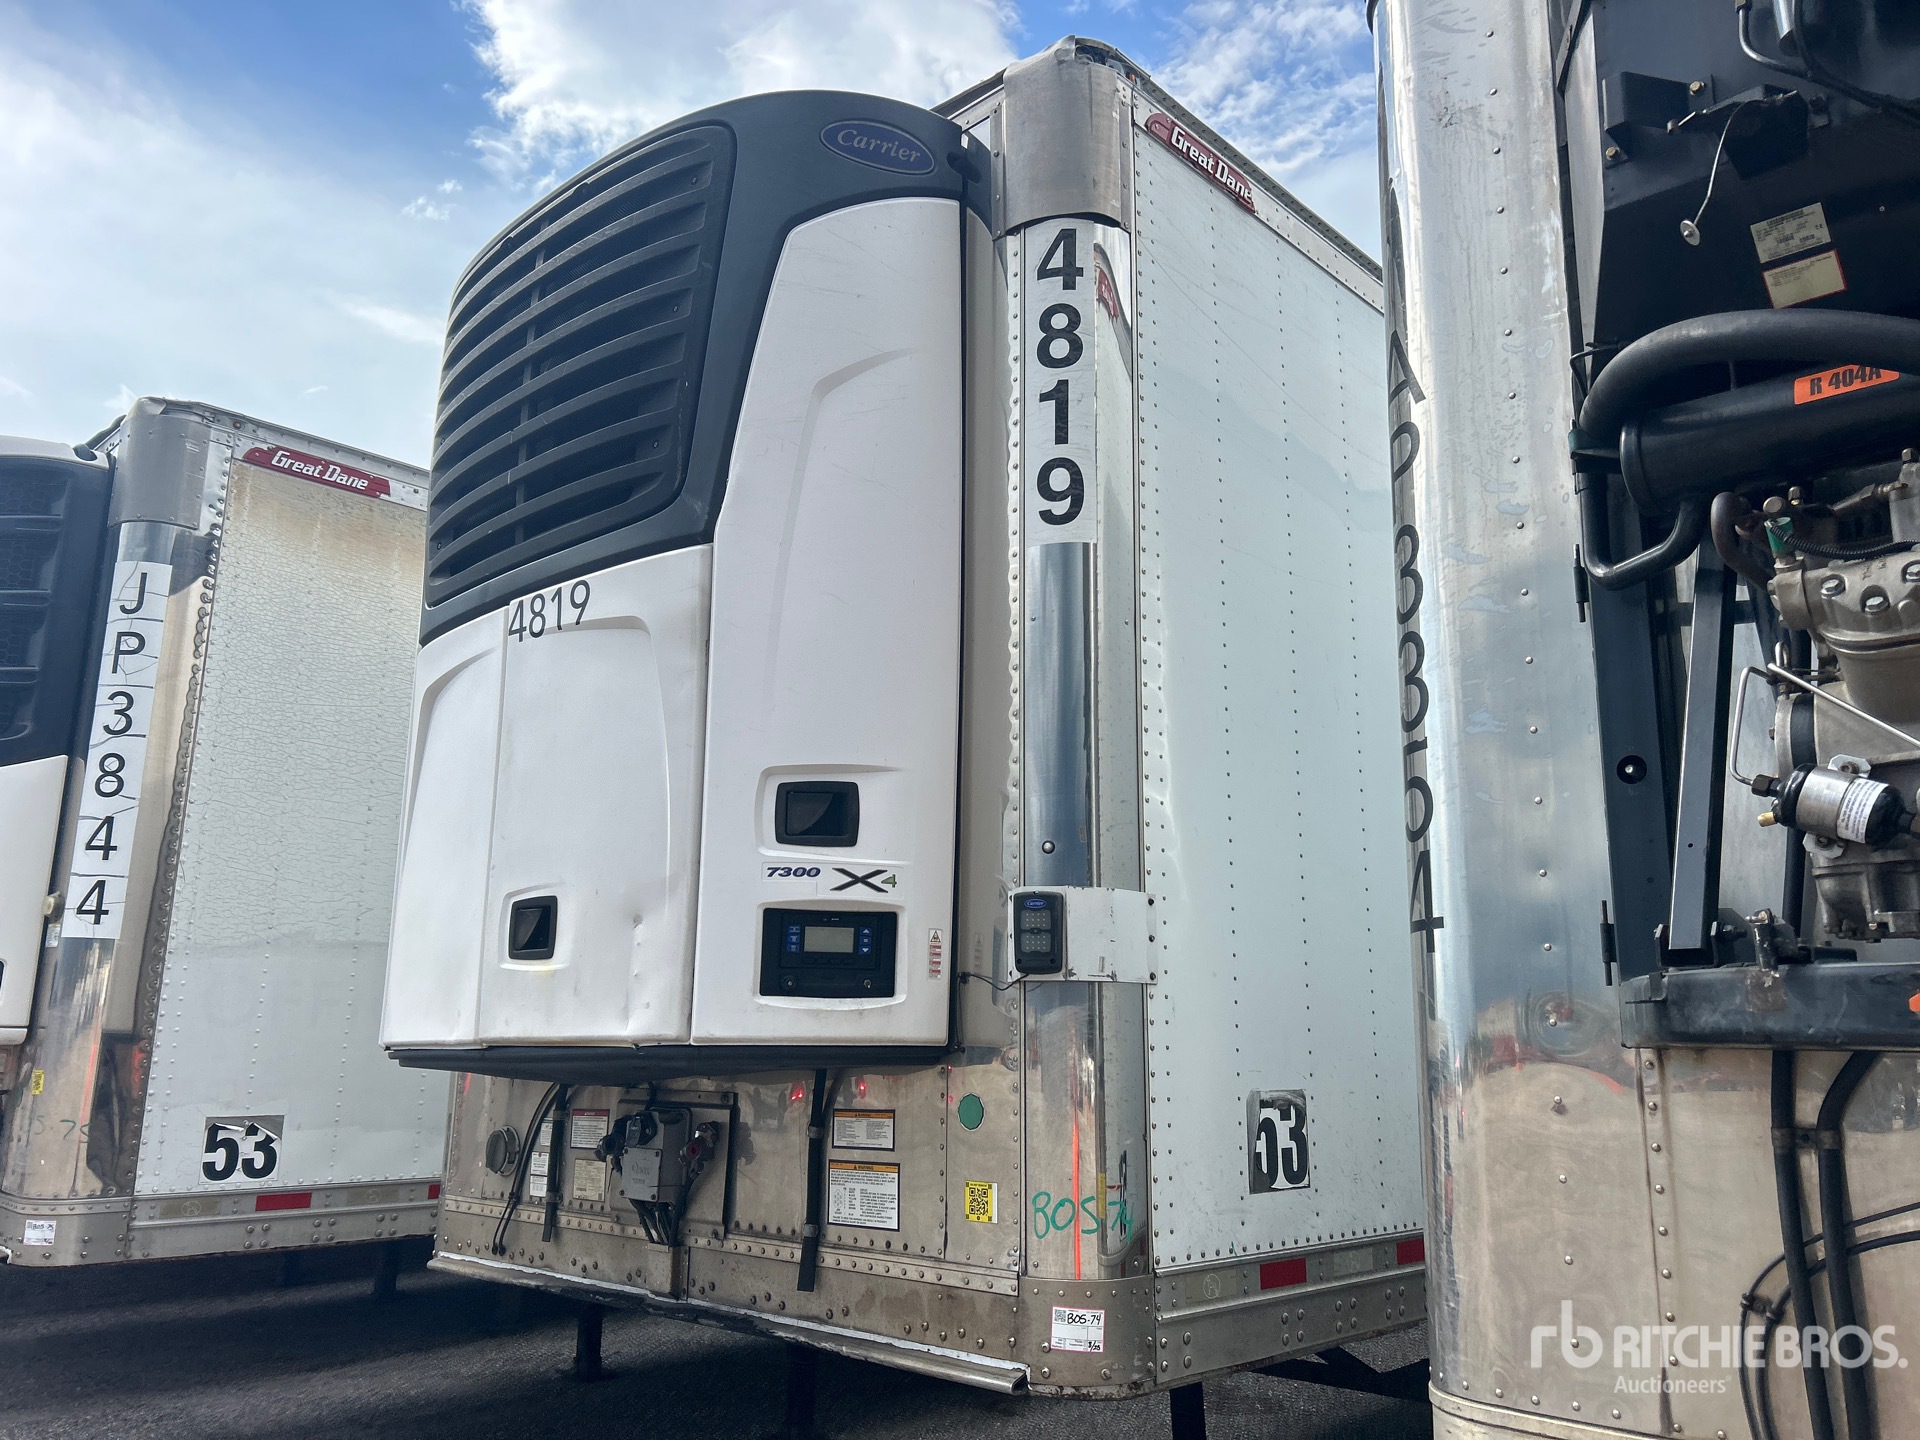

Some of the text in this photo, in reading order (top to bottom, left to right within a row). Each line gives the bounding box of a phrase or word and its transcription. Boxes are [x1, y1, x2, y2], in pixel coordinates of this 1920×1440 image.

[837, 128, 921, 163] Carrier
[1170, 125, 1254, 203] Great Dane
[1036, 228, 1084, 526] 4819
[1810, 366, 1882, 396] R 404A
[271, 449, 369, 492] Great Dane
[509, 580, 591, 643] 4819
[76, 571, 147, 926] JP3844
[767, 867, 821, 878] 7300
[202, 1121, 279, 1181] 53
[1032, 1191, 1100, 1240] BOS
[1067, 1312, 1101, 1326] BOS-74
